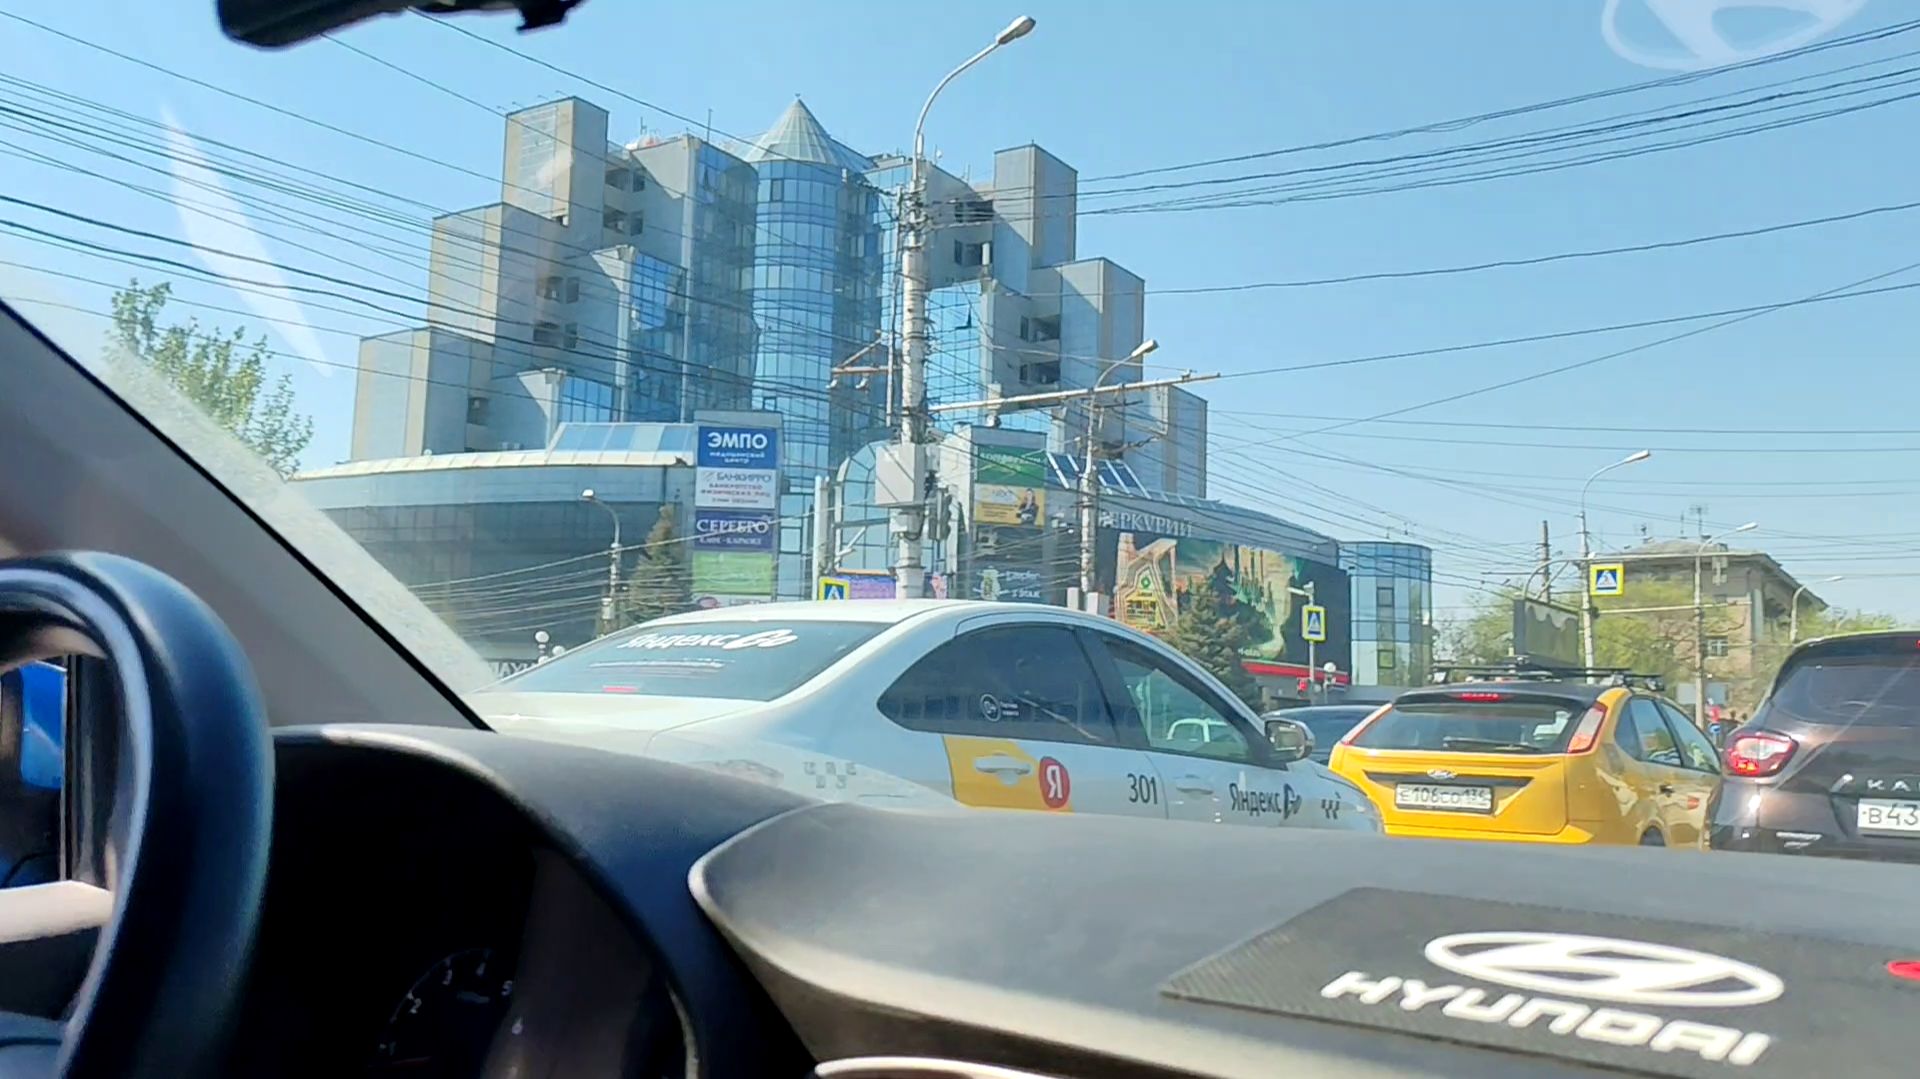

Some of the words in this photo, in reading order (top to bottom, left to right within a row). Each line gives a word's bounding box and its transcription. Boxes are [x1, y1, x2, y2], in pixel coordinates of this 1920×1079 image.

[707, 432, 768, 449] ЭМПО
[696, 519, 769, 534] СЕРЕБРО
[616, 632, 741, 650] Яндекс
[722, 628, 798, 650] Go
[1045, 760, 1063, 799] Я
[1126, 772, 1158, 805] 301
[1866, 779, 1920, 792] KA
[1229, 782, 1282, 817] Яндекс
[1283, 783, 1303, 820] Go
[1320, 971, 1772, 1066] HYUNDAI
